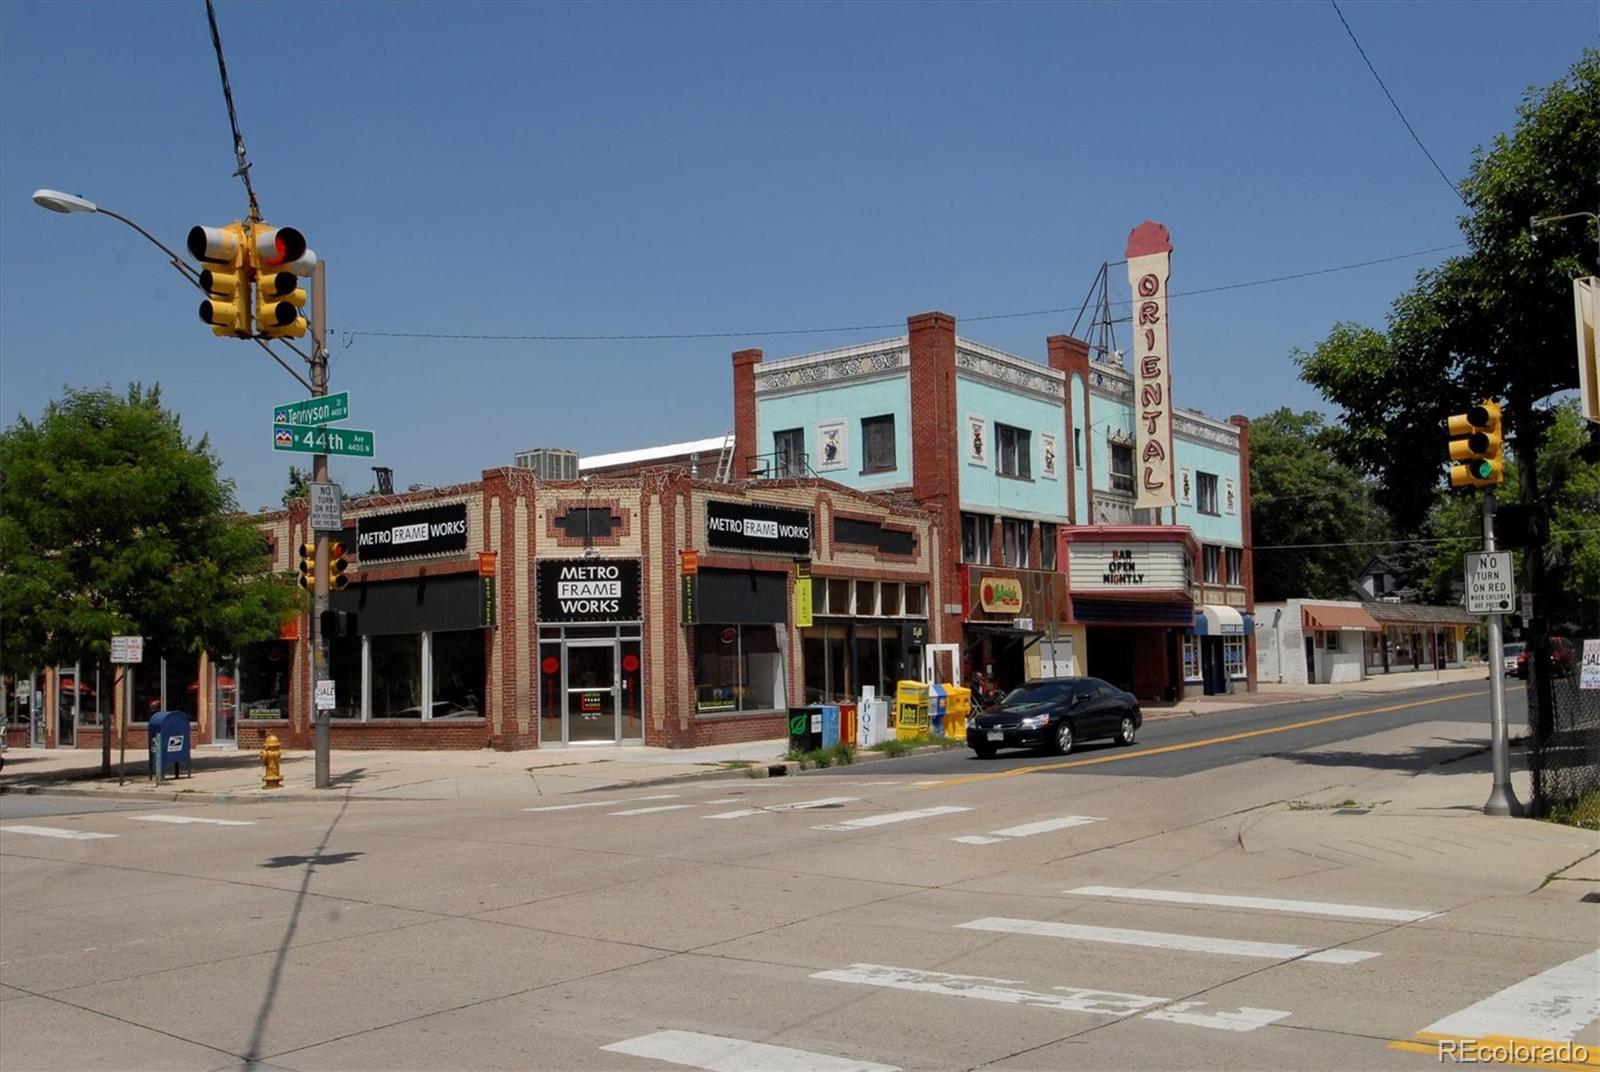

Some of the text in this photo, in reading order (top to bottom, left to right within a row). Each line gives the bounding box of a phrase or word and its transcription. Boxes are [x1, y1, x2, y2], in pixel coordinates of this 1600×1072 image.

[1138, 273, 1165, 491] ORIENTAL
[288, 404, 329, 425] Tennyson
[303, 431, 343, 450] 44th
[353, 434, 364, 443] Ave
[348, 443, 364, 452] 4400
[320, 486, 331, 496] NO
[318, 496, 334, 505] TURN
[314, 505, 338, 513] ON RED
[359, 520, 465, 546] METRO FRAME WORKS
[709, 517, 809, 539] METRO FRAME WORKS
[1112, 549, 1132, 560] BAR
[1109, 562, 1136, 572] OPEN
[1480, 557, 1497, 569] NO
[560, 566, 619, 580] METRO
[1103, 573, 1144, 585] NIGHTLY
[1477, 571, 1499, 581] TURN
[562, 583, 617, 596] FRAME
[1473, 582, 1506, 592] ON RED
[560, 599, 619, 613] WORKS
[1583, 653, 1600, 666] SAL
[862, 703, 871, 744] POST
